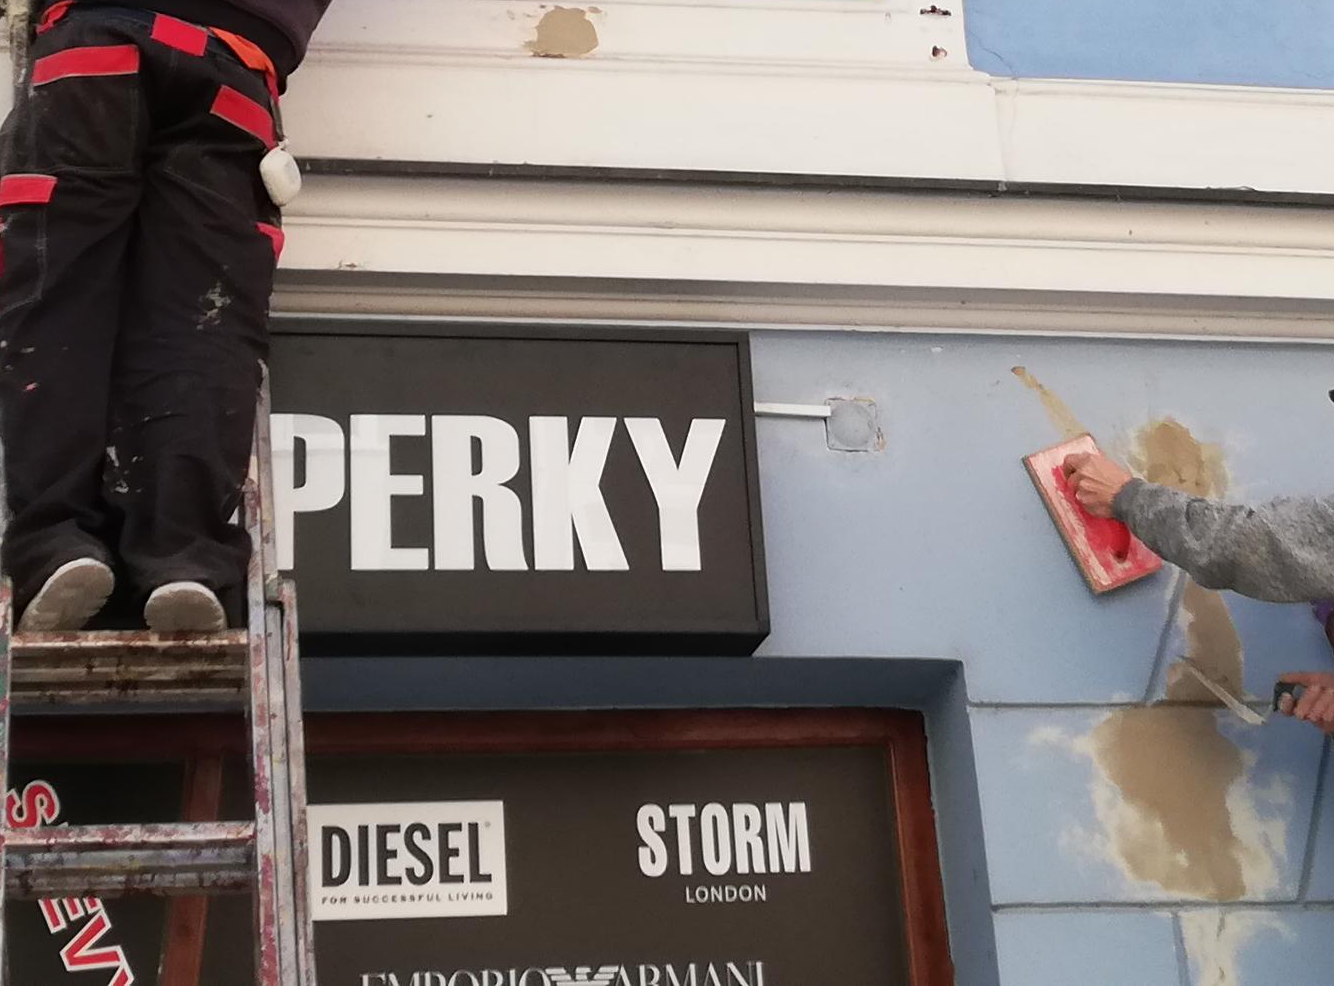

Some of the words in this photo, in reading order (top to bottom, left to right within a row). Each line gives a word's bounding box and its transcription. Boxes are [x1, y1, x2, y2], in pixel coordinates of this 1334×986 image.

[227, 414, 727, 571] PERKY
[321, 822, 493, 888] DIESEL
[636, 802, 812, 877] STORM
[321, 896, 347, 905] FOR
[354, 893, 442, 904] SUCCESSFUL
[448, 892, 494, 902] LIVING
[685, 884, 767, 904] LONDON
